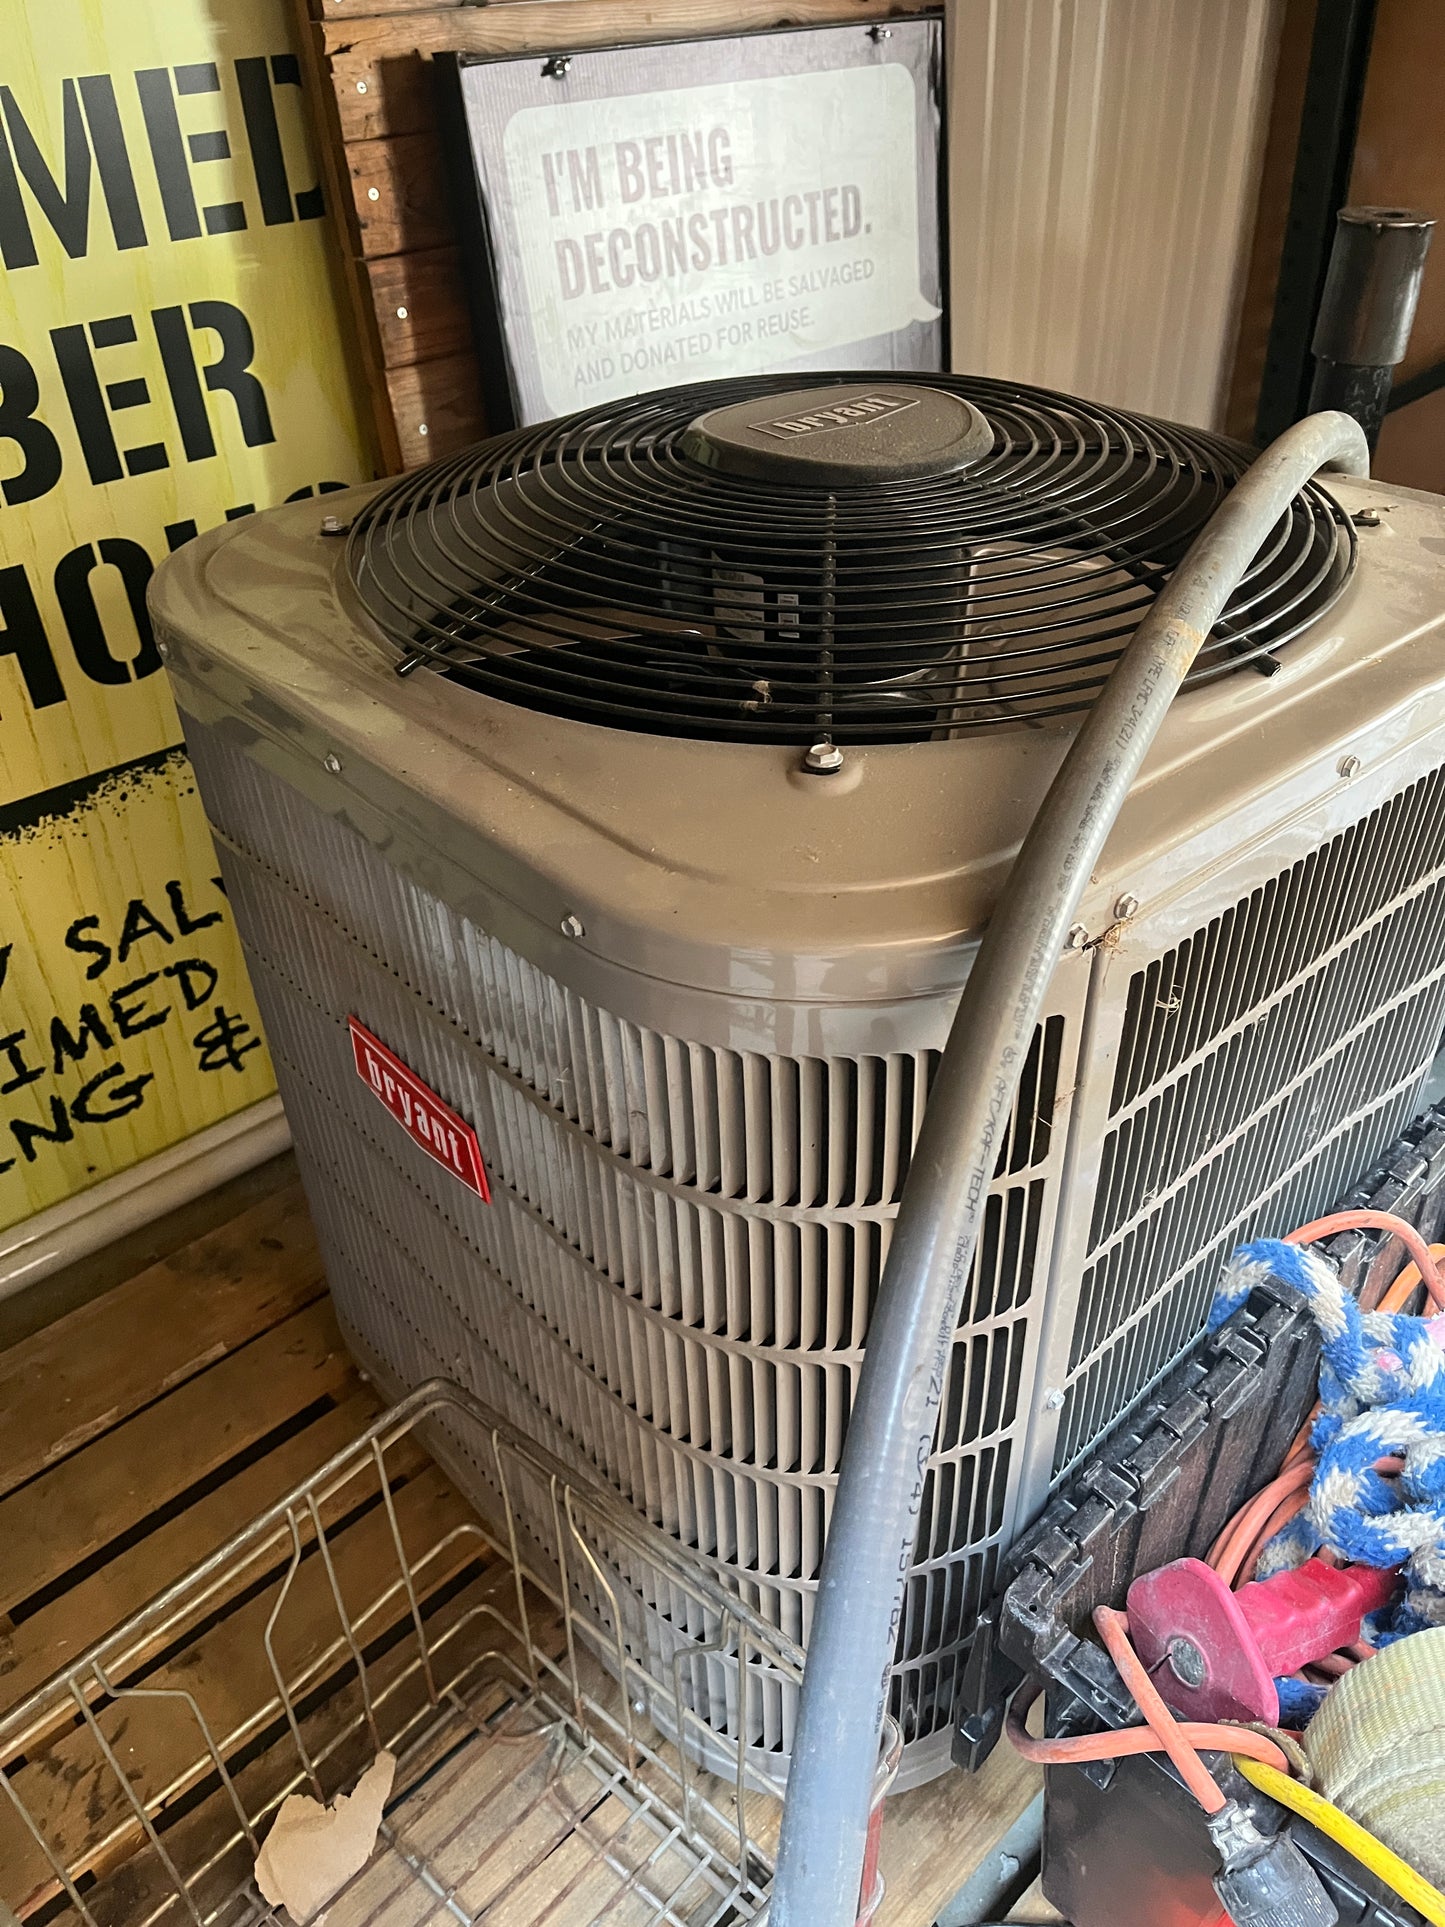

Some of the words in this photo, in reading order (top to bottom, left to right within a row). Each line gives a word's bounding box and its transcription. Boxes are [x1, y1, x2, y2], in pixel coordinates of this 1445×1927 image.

[542, 145, 604, 217] I'M
[615, 127, 733, 204] BEING
[554, 185, 872, 301] DECONSTRUCTED.
[566, 324, 600, 354] MY
[605, 297, 711, 347] MATERIALS
[715, 288, 759, 316] WILL
[763, 279, 785, 303] BE
[788, 258, 876, 297] SALVAGED
[573, 358, 615, 389] AND
[620, 331, 713, 374] DONATED
[717, 321, 752, 349] FOR
[757, 306, 816, 336] REUSE.
[773, 397, 900, 433] bryant
[65, 876, 226, 981] SAL
[0, 1062, 153, 1174] NG
[364, 1047, 464, 1173] bryant
